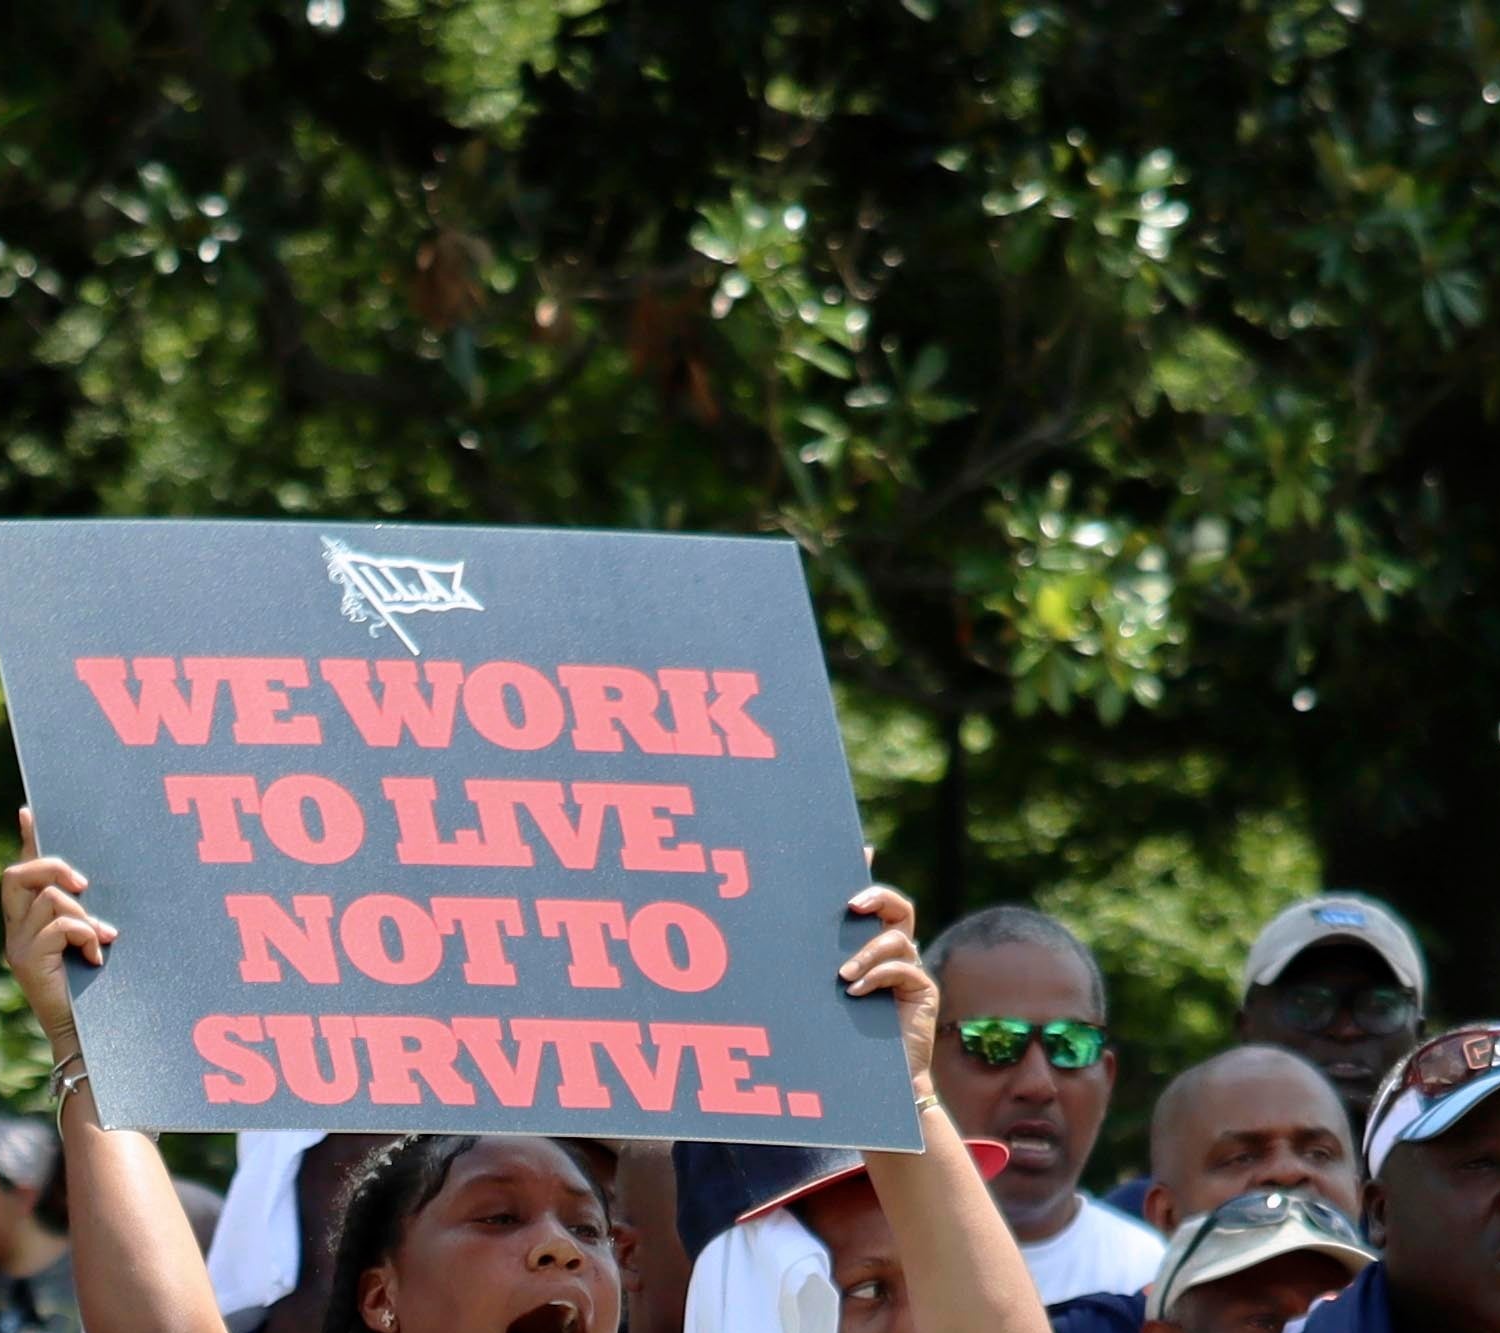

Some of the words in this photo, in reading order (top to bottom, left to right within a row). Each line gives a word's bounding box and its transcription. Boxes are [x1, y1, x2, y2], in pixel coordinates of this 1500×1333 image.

[75, 655, 323, 747] WE
[318, 657, 778, 760] WORK
[164, 772, 365, 867] TO
[381, 776, 752, 901] LIVE,
[225, 893, 525, 988] NOT
[535, 897, 730, 995] TO
[193, 1013, 823, 1120] SURVIVE.
